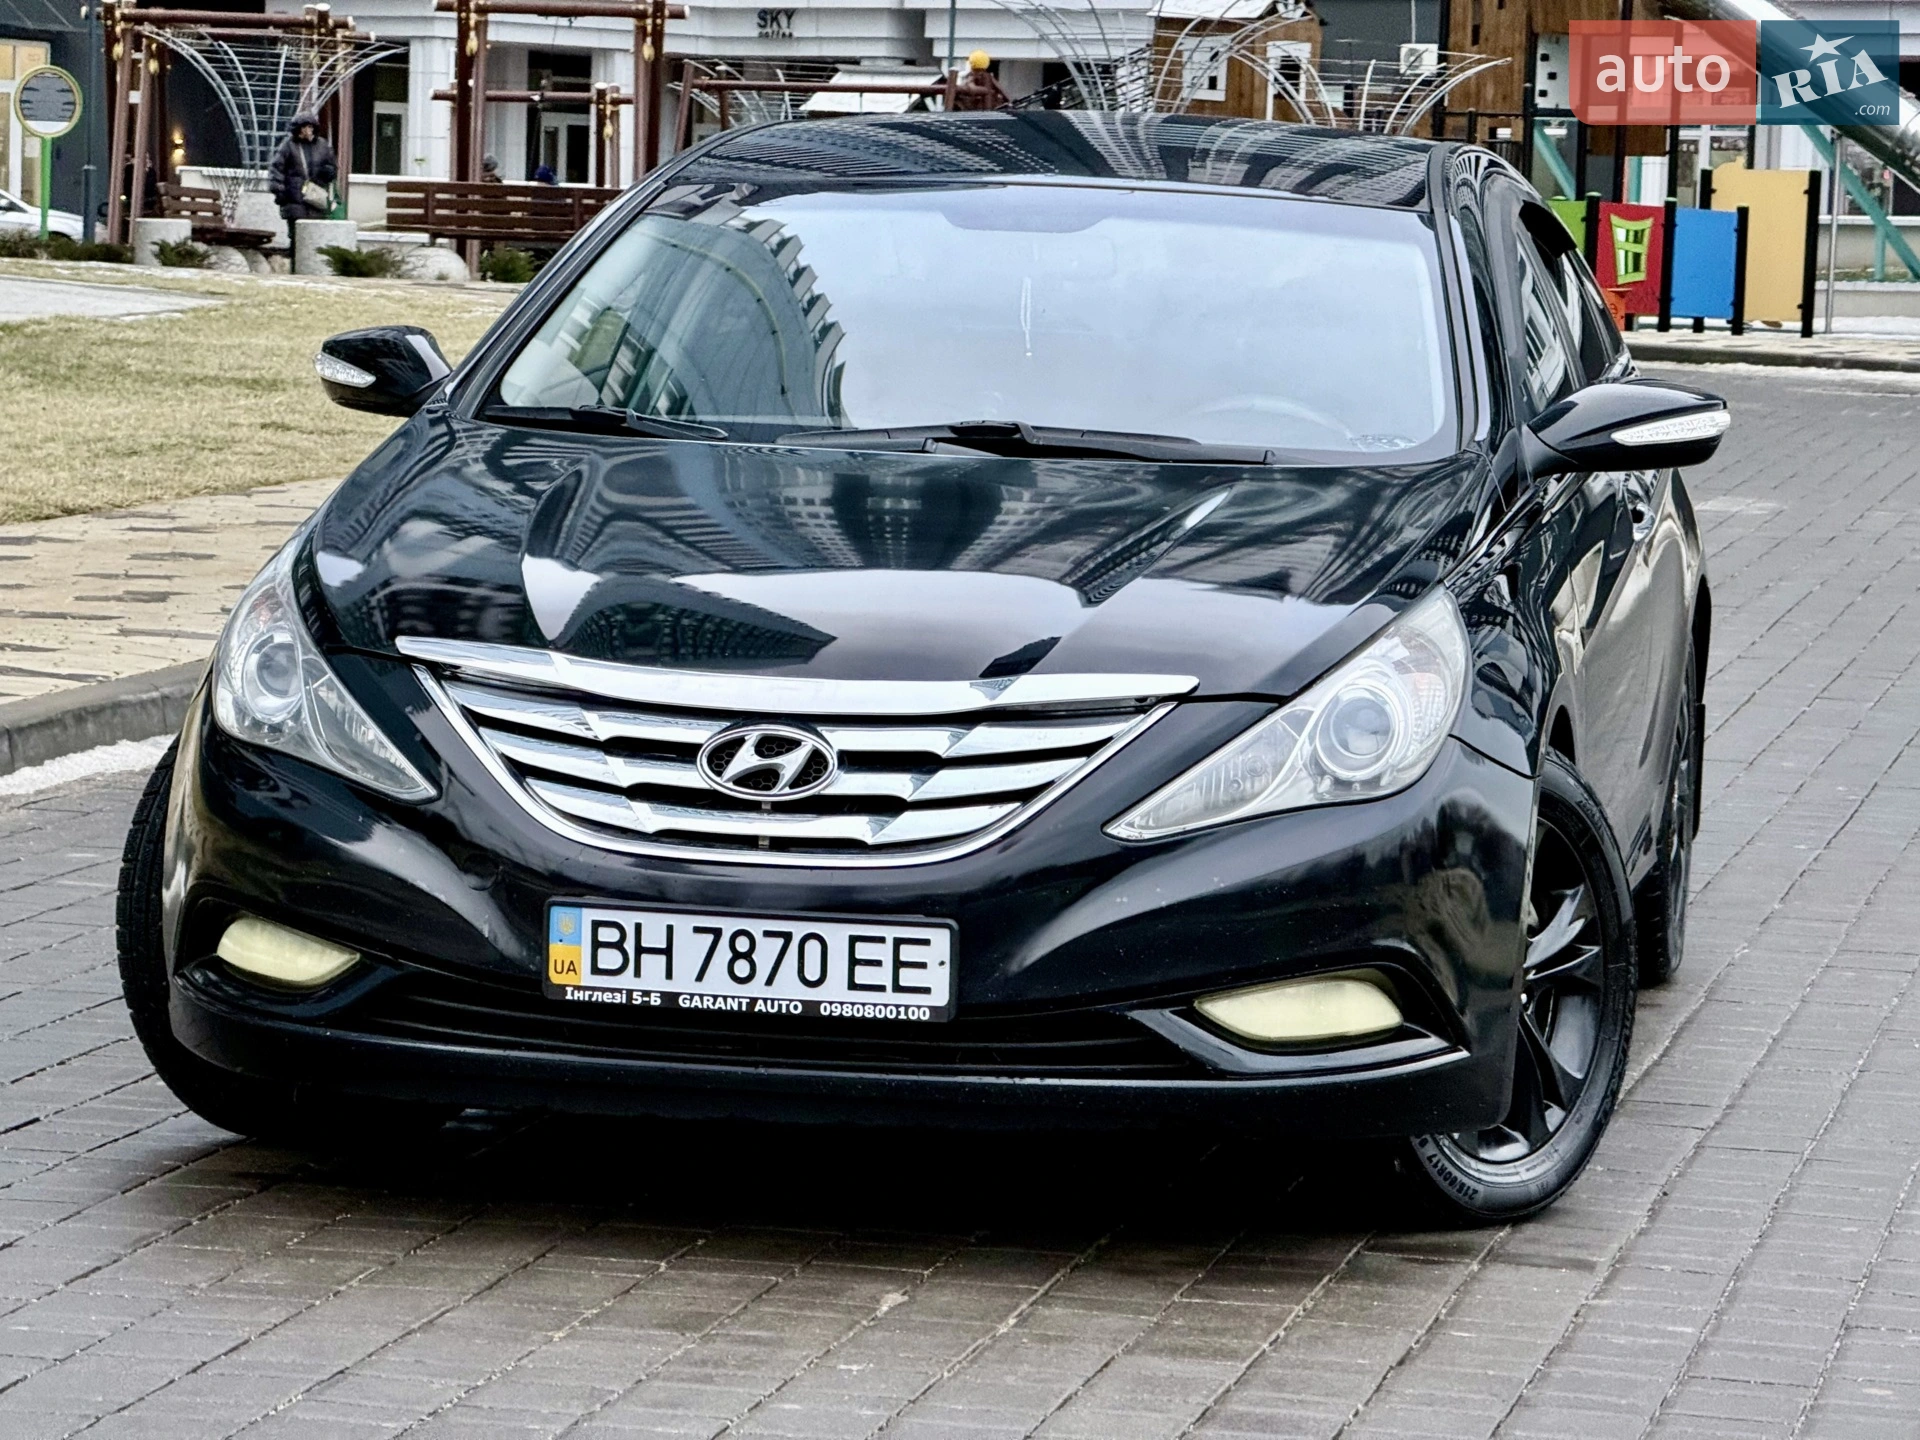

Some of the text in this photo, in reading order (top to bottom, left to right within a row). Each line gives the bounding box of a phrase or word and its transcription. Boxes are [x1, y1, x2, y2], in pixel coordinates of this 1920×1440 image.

[757, 8, 797, 29] SKY
[553, 959, 578, 976] UA
[590, 918, 932, 995] BH 7870 EE
[678, 994, 930, 1021] GARANT AUTO 0980800100
